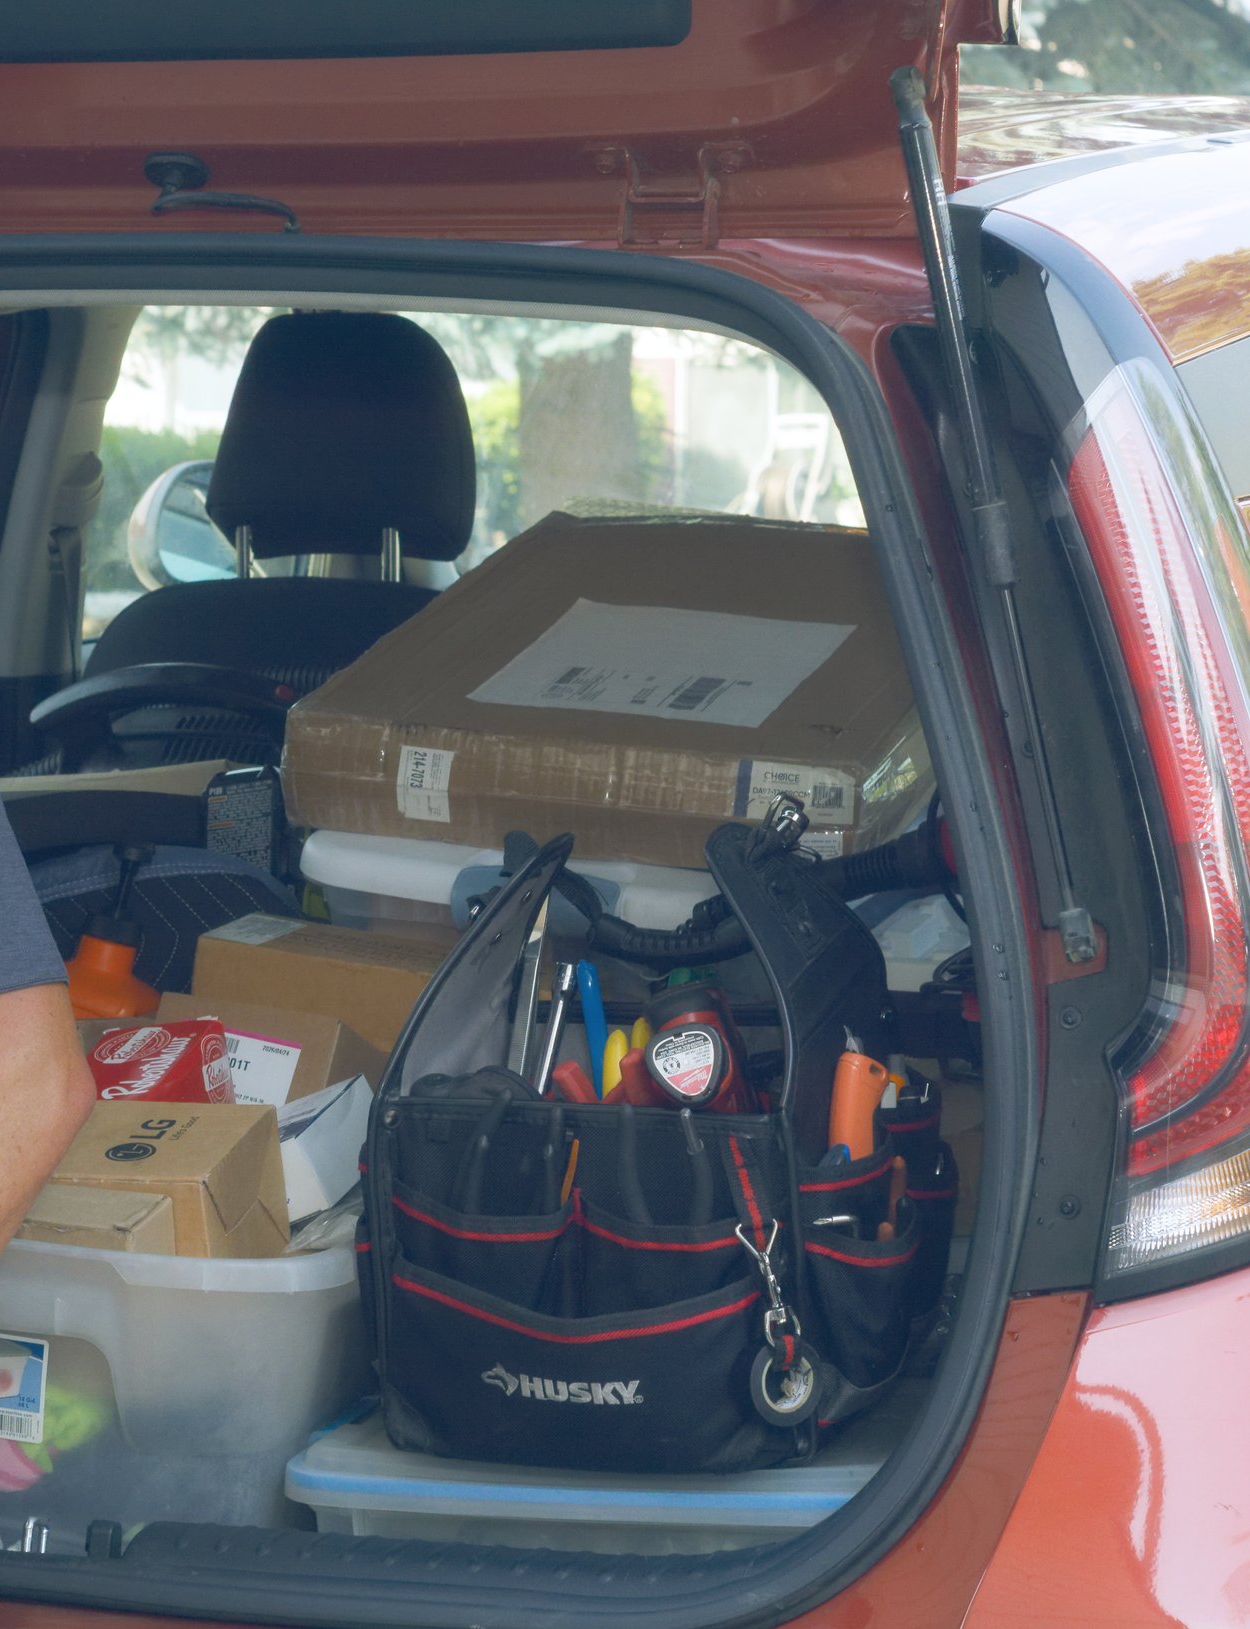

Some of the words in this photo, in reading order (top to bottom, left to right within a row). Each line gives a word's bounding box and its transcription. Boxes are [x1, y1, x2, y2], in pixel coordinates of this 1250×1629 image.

[409, 751, 428, 788] 214-7073
[228, 1057, 251, 1072] 01T
[129, 1118, 177, 1140] LG
[519, 1373, 640, 1406] HUSKY
